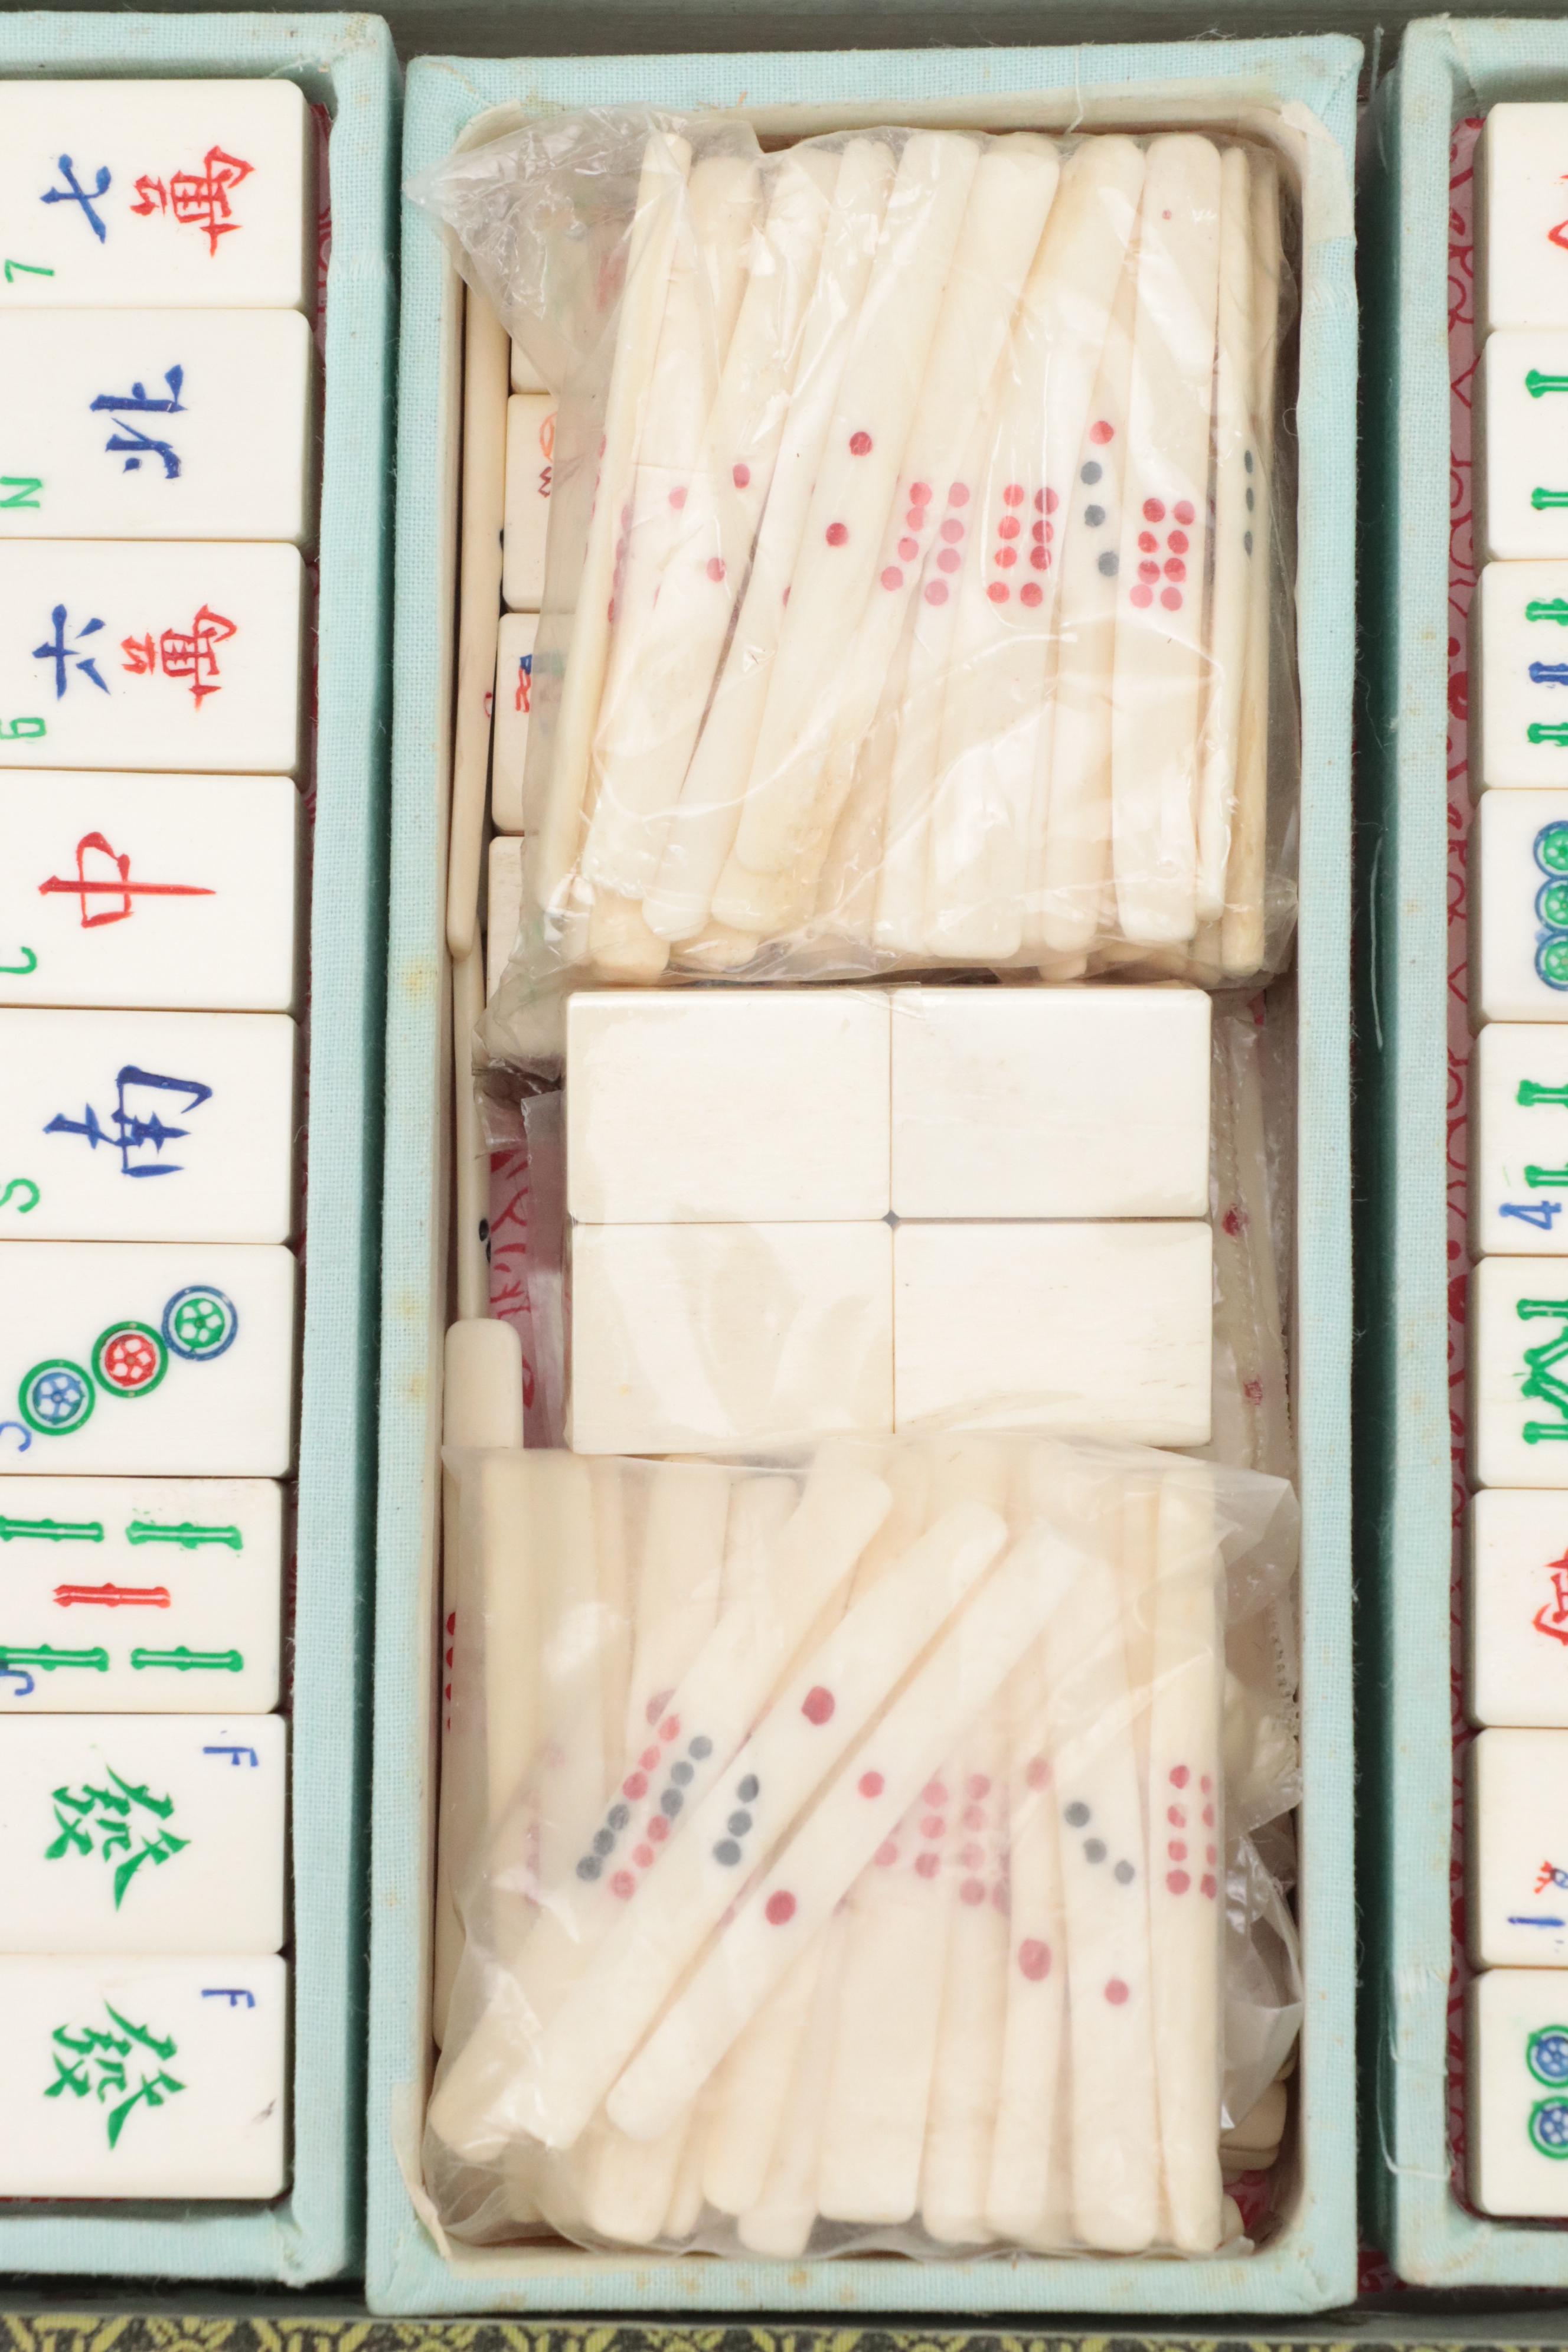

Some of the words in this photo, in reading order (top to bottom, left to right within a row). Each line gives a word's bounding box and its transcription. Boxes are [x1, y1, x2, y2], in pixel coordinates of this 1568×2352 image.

[40, 145, 256, 258] 七萬
[4, 259, 55, 283] 7
[90, 364, 188, 479] 北
[0, 476, 43, 508] N
[32, 603, 238, 711] 六萬
[38, 831, 217, 929] 中
[43, 1065, 213, 1178] 南
[1500, 1200, 1562, 1230] 4
[203, 1746, 258, 1767] F
[44, 1764, 191, 1912] 發
[201, 1989, 256, 2007] F
[43, 2000, 187, 2150] 發
